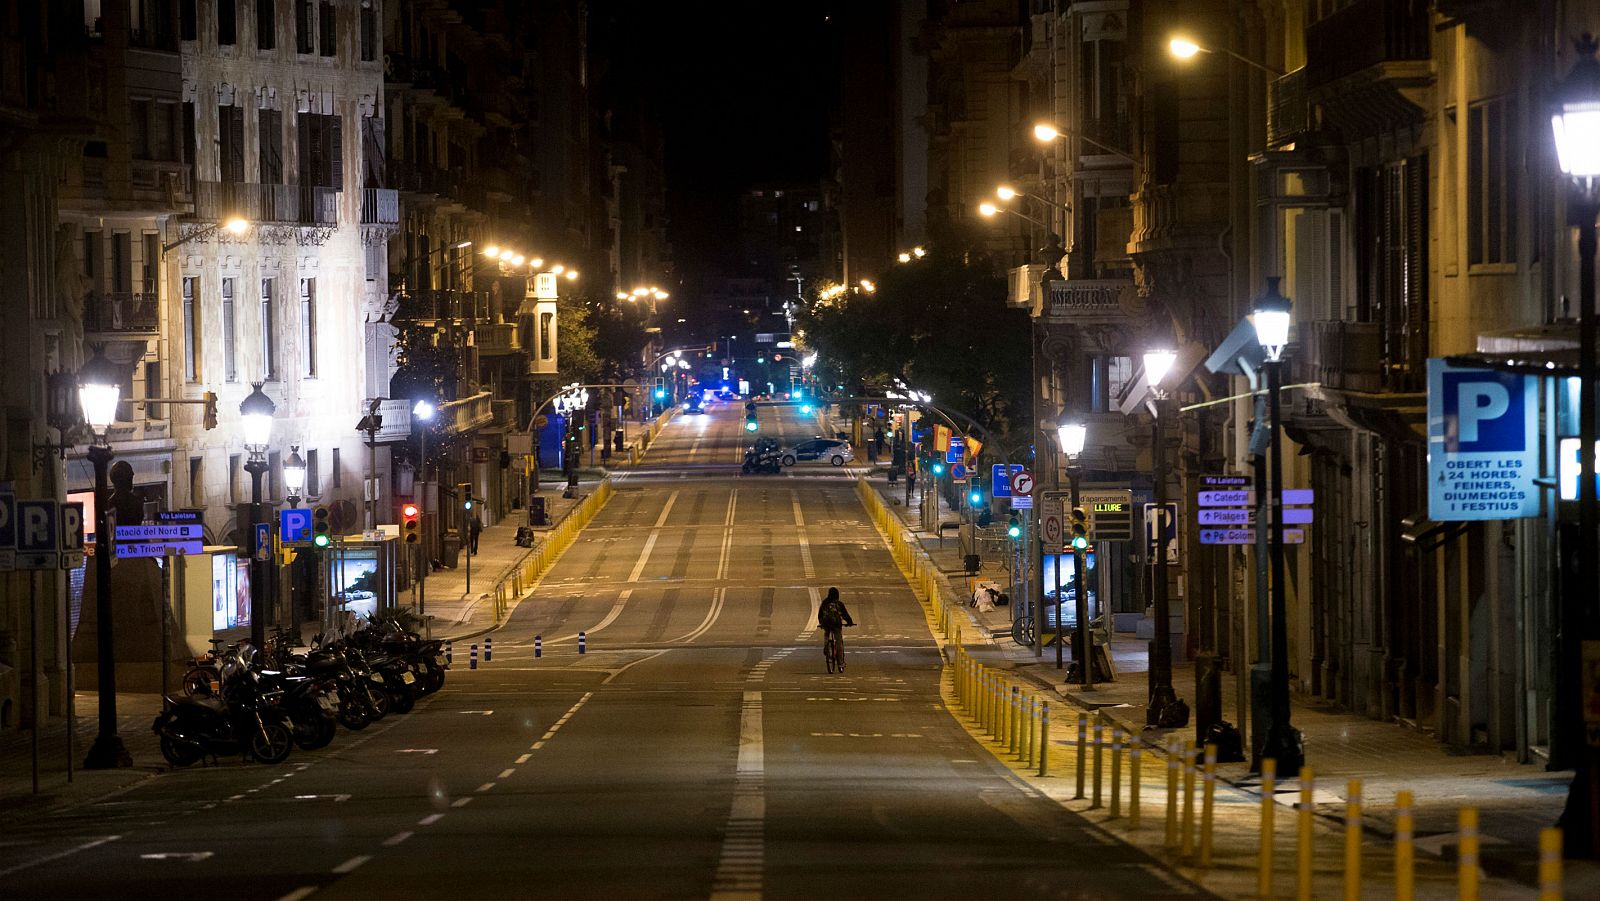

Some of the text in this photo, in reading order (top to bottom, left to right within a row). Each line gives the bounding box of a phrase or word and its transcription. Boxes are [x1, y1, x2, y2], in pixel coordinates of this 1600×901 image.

[1457, 381, 1510, 442] P
[1446, 459, 1523, 469] OBERT LES
[1448, 470, 1464, 480] 24
[1454, 481, 1516, 491] FEINERS,
[1213, 493, 1248, 502] Catedral
[1444, 491, 1526, 501] DIUMENGES
[1094, 503, 1122, 512] LLIURE
[1451, 501, 1519, 511] I FESTIUS
[1213, 511, 1246, 521] Platges
[287, 513, 305, 538] P
[143, 527, 156, 535] del
[158, 527, 178, 535] Nord
[1228, 531, 1255, 540] Colom
[127, 545, 138, 554] de
